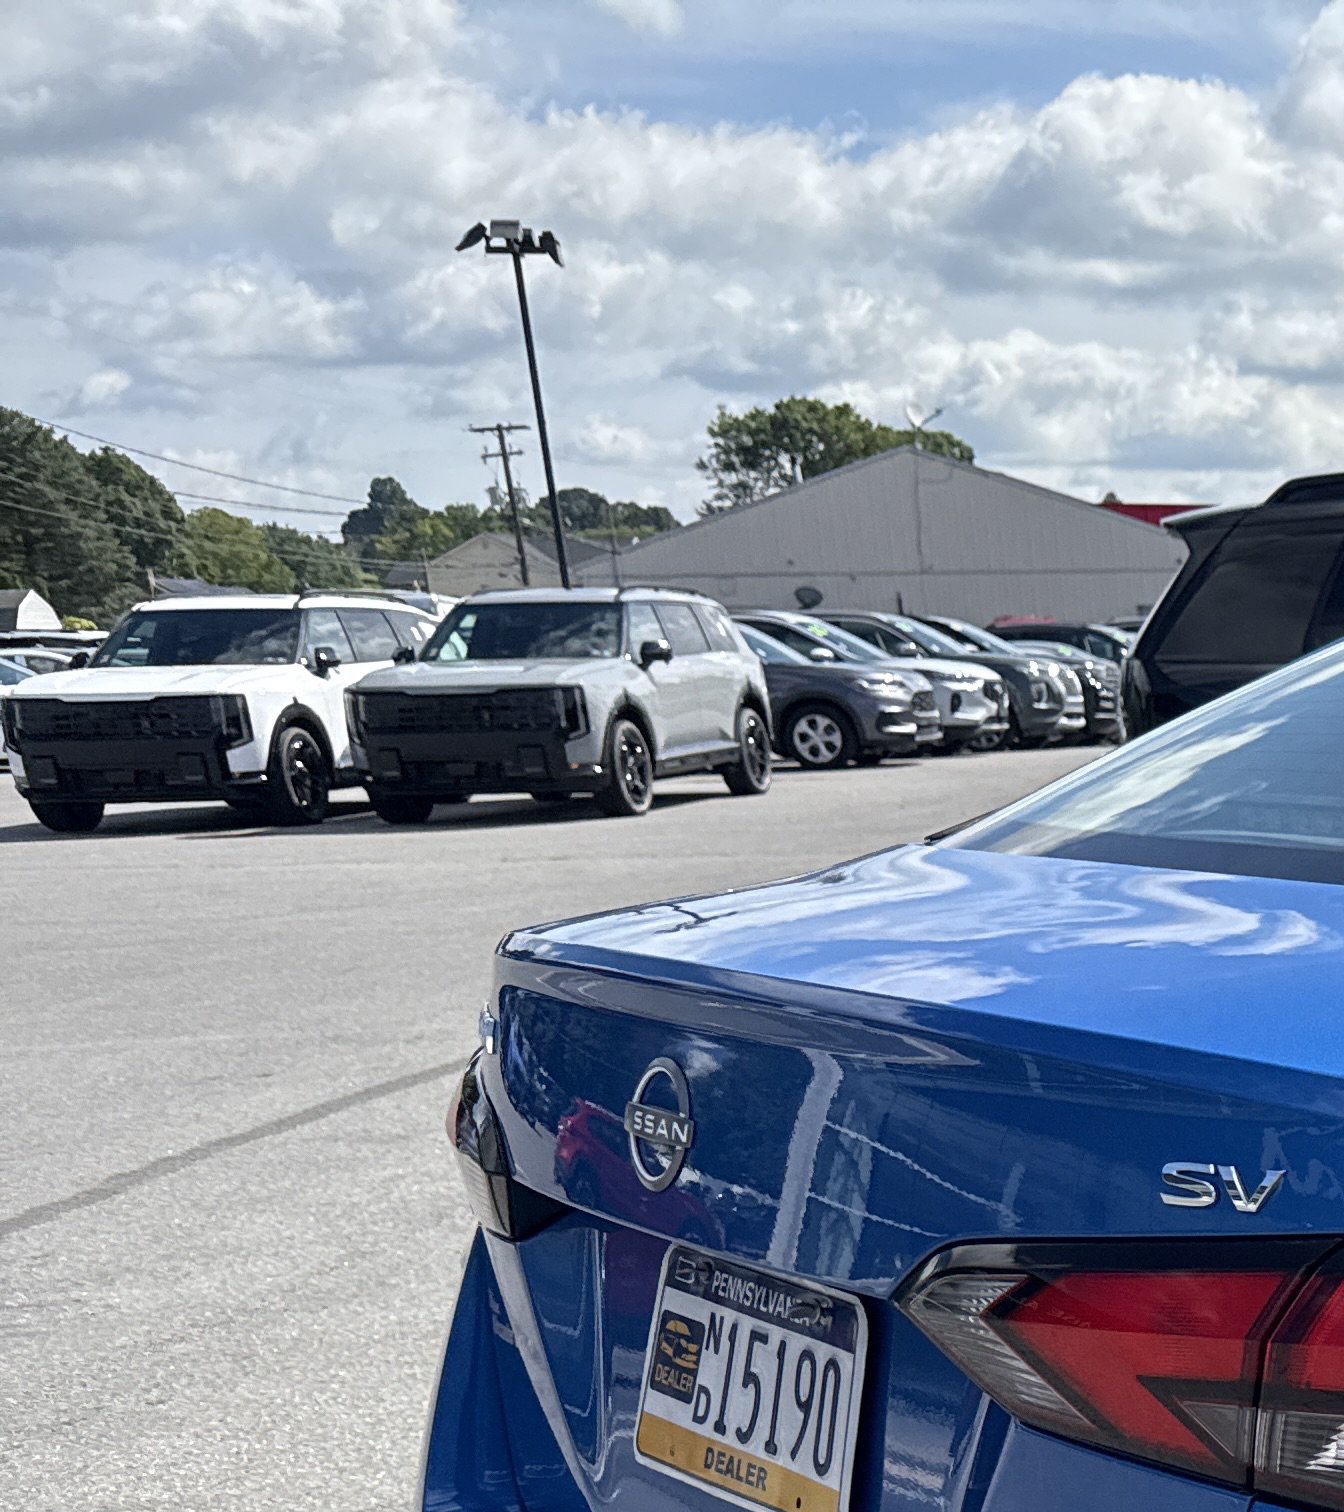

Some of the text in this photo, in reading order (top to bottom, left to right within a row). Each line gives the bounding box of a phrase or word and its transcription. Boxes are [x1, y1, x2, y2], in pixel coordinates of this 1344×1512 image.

[1160, 1161, 1287, 1213] SV
[654, 1363, 694, 1394] DEALER
[713, 1318, 842, 1478] 15190
[703, 1446, 768, 1492] DEALER
